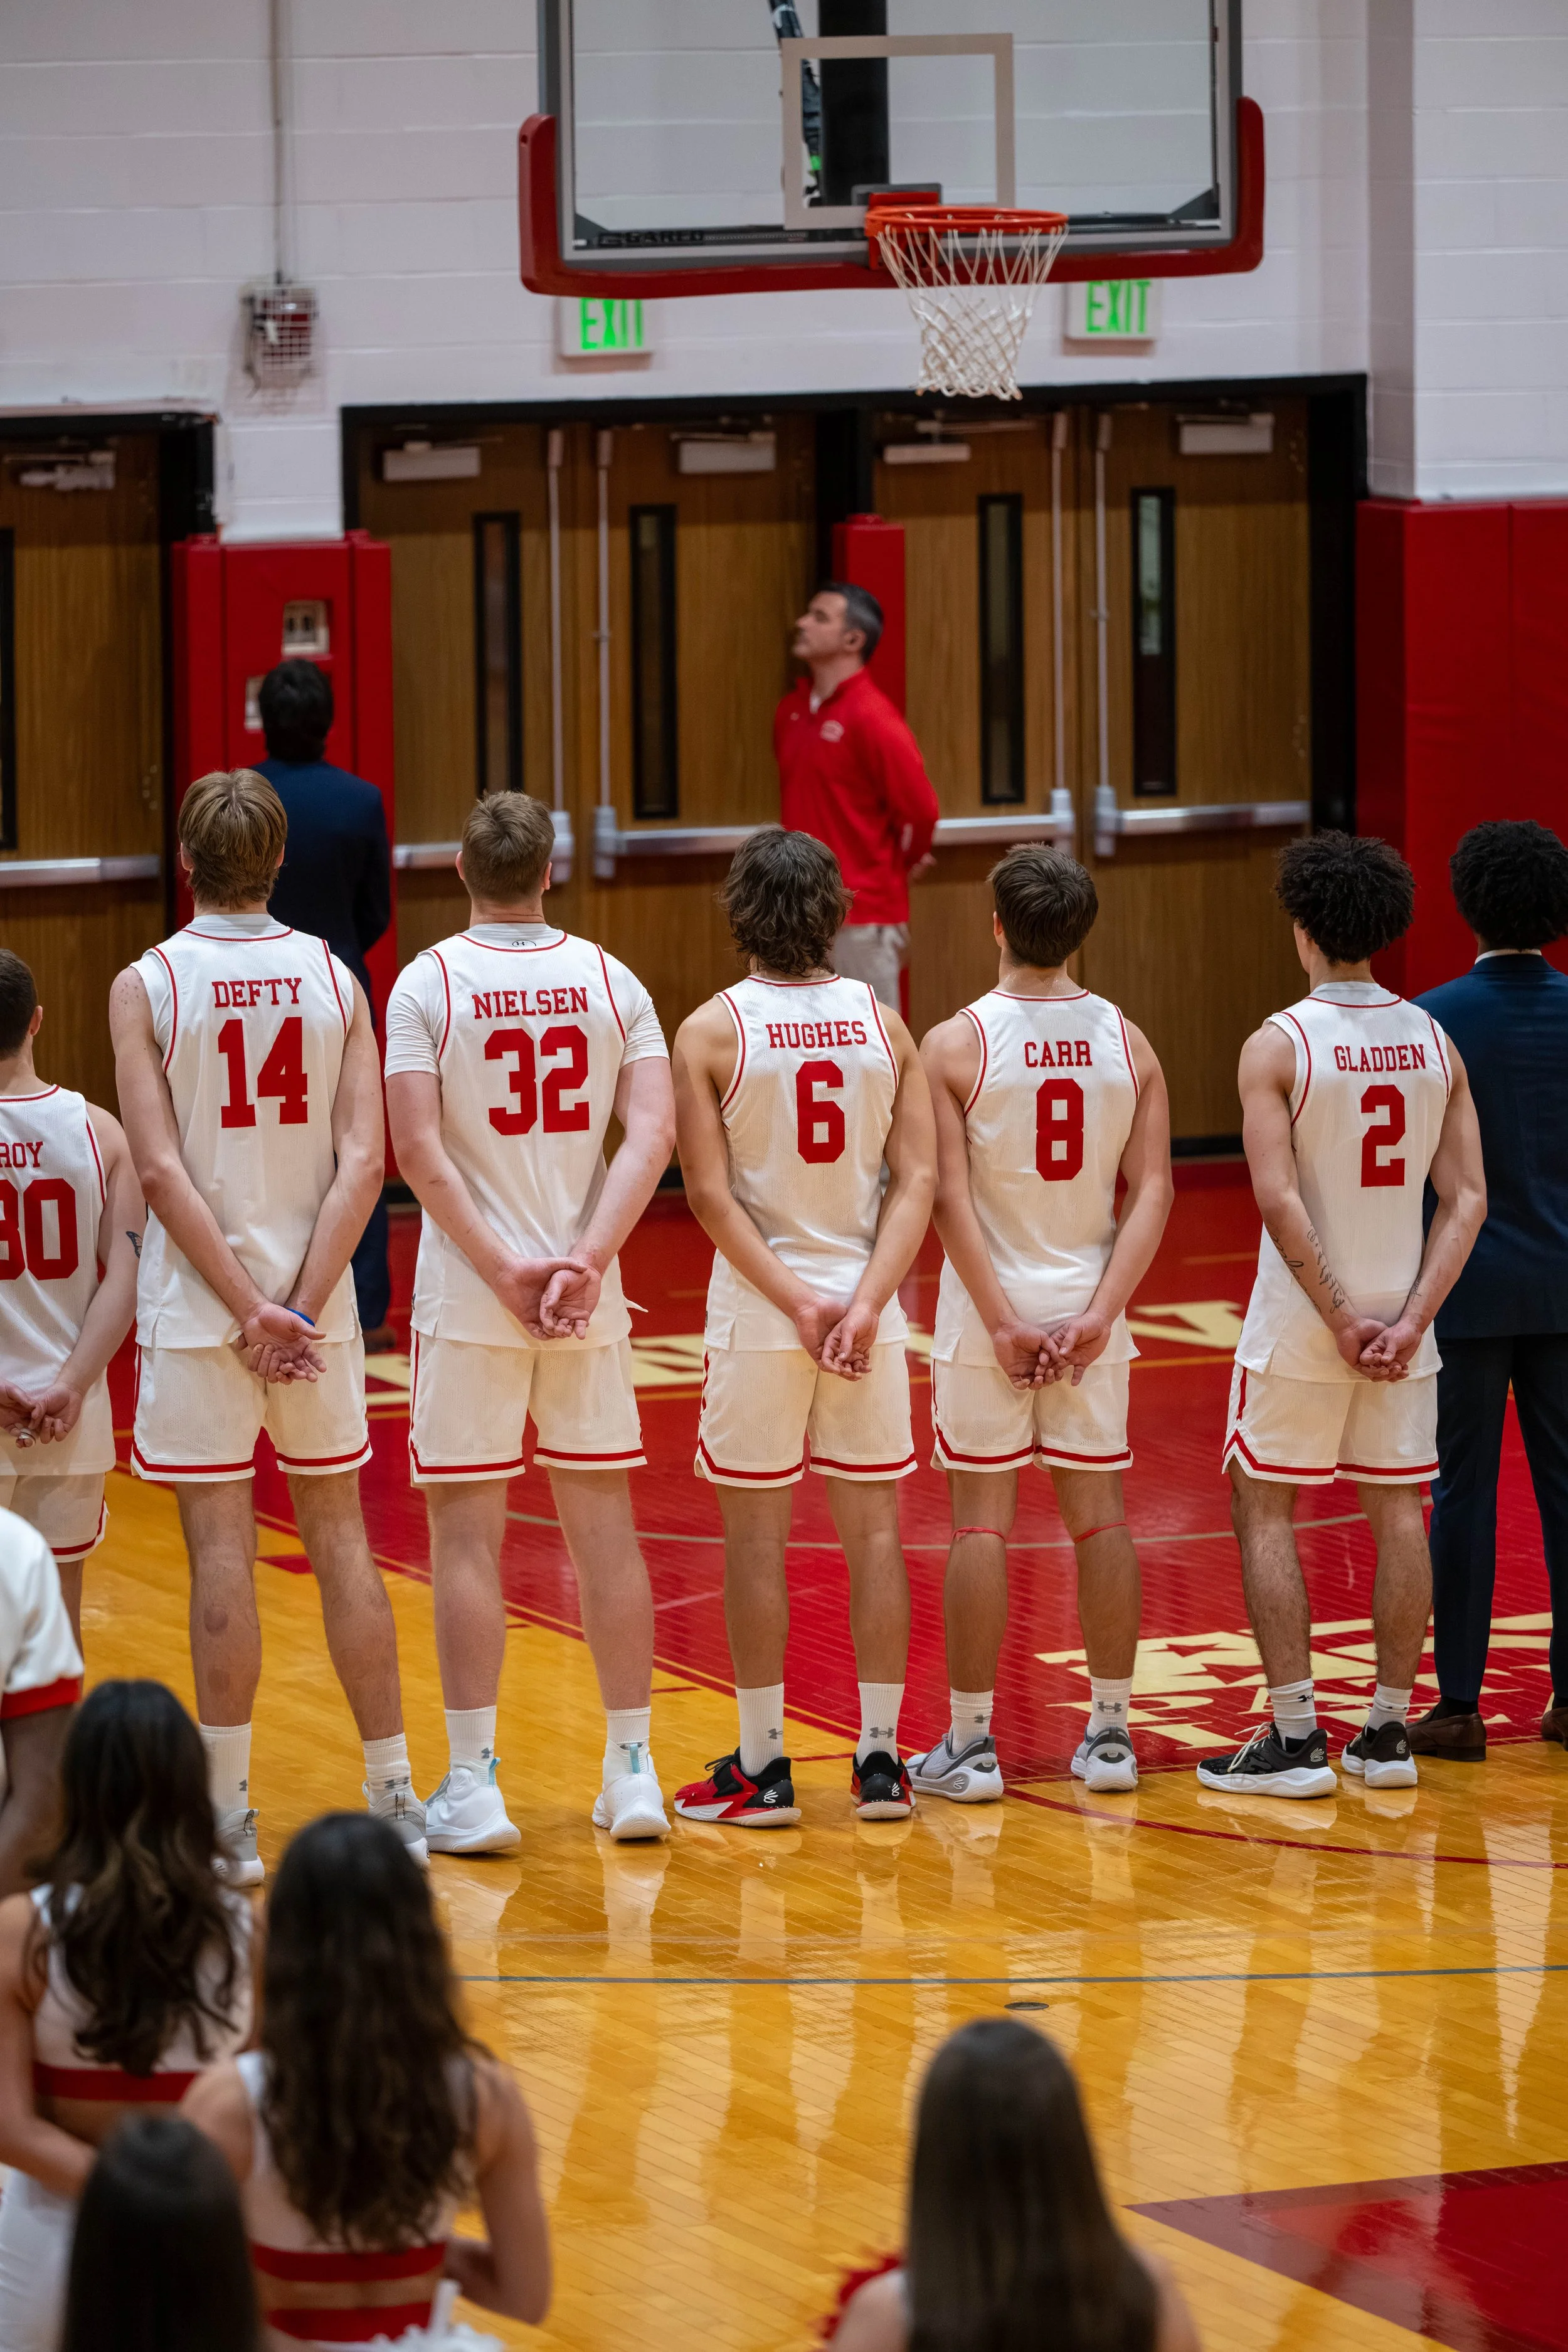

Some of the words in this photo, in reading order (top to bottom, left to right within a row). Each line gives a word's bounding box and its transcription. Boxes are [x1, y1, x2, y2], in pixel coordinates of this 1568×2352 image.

[1086, 279, 1152, 333] EXIT
[212, 978, 301, 1007] DEFTY
[472, 988, 588, 1019] NIELSEN
[766, 1022, 866, 1048] HUGHES
[1025, 1041, 1092, 1067] CARR
[1335, 1044, 1425, 1071] GLADDEN
[218, 1017, 308, 1128] 14
[485, 1025, 589, 1135] 32
[796, 1061, 845, 1164] 6
[1036, 1079, 1083, 1181] 8
[1361, 1085, 1405, 1187] 2
